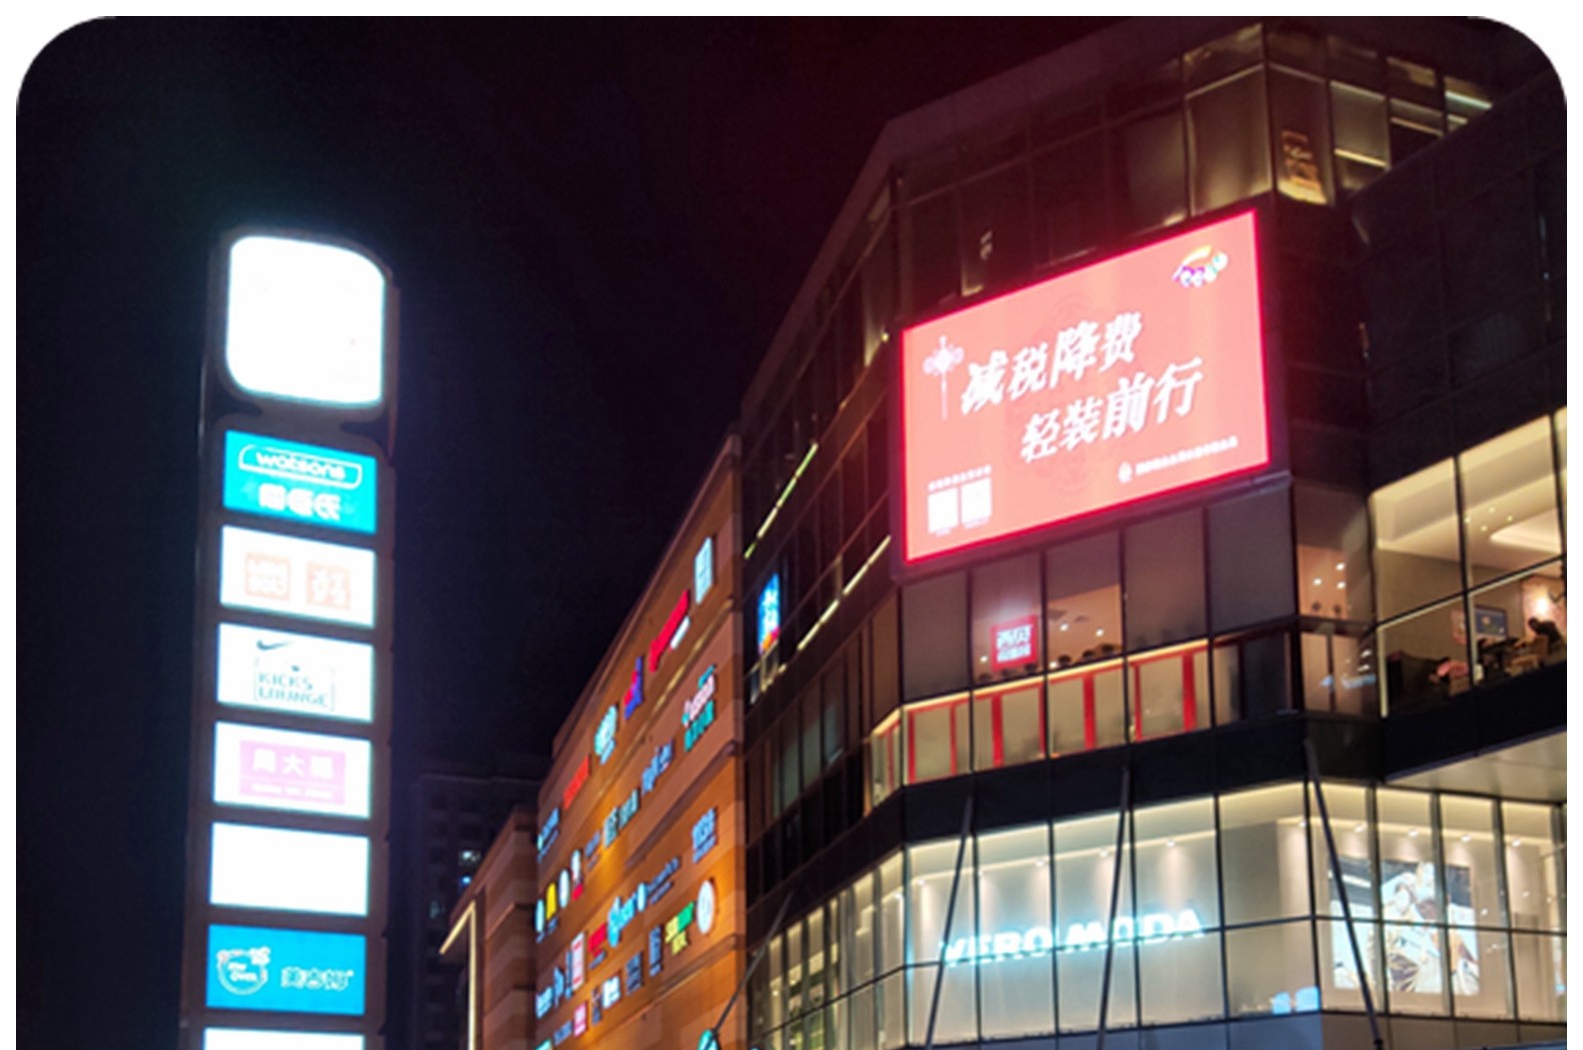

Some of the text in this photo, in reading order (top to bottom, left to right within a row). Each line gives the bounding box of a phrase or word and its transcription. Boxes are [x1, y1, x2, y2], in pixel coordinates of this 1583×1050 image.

[960, 311, 1143, 416] 减税降费
[1020, 357, 1204, 463] 轻装前行
[938, 909, 1206, 968] VERO MODA
